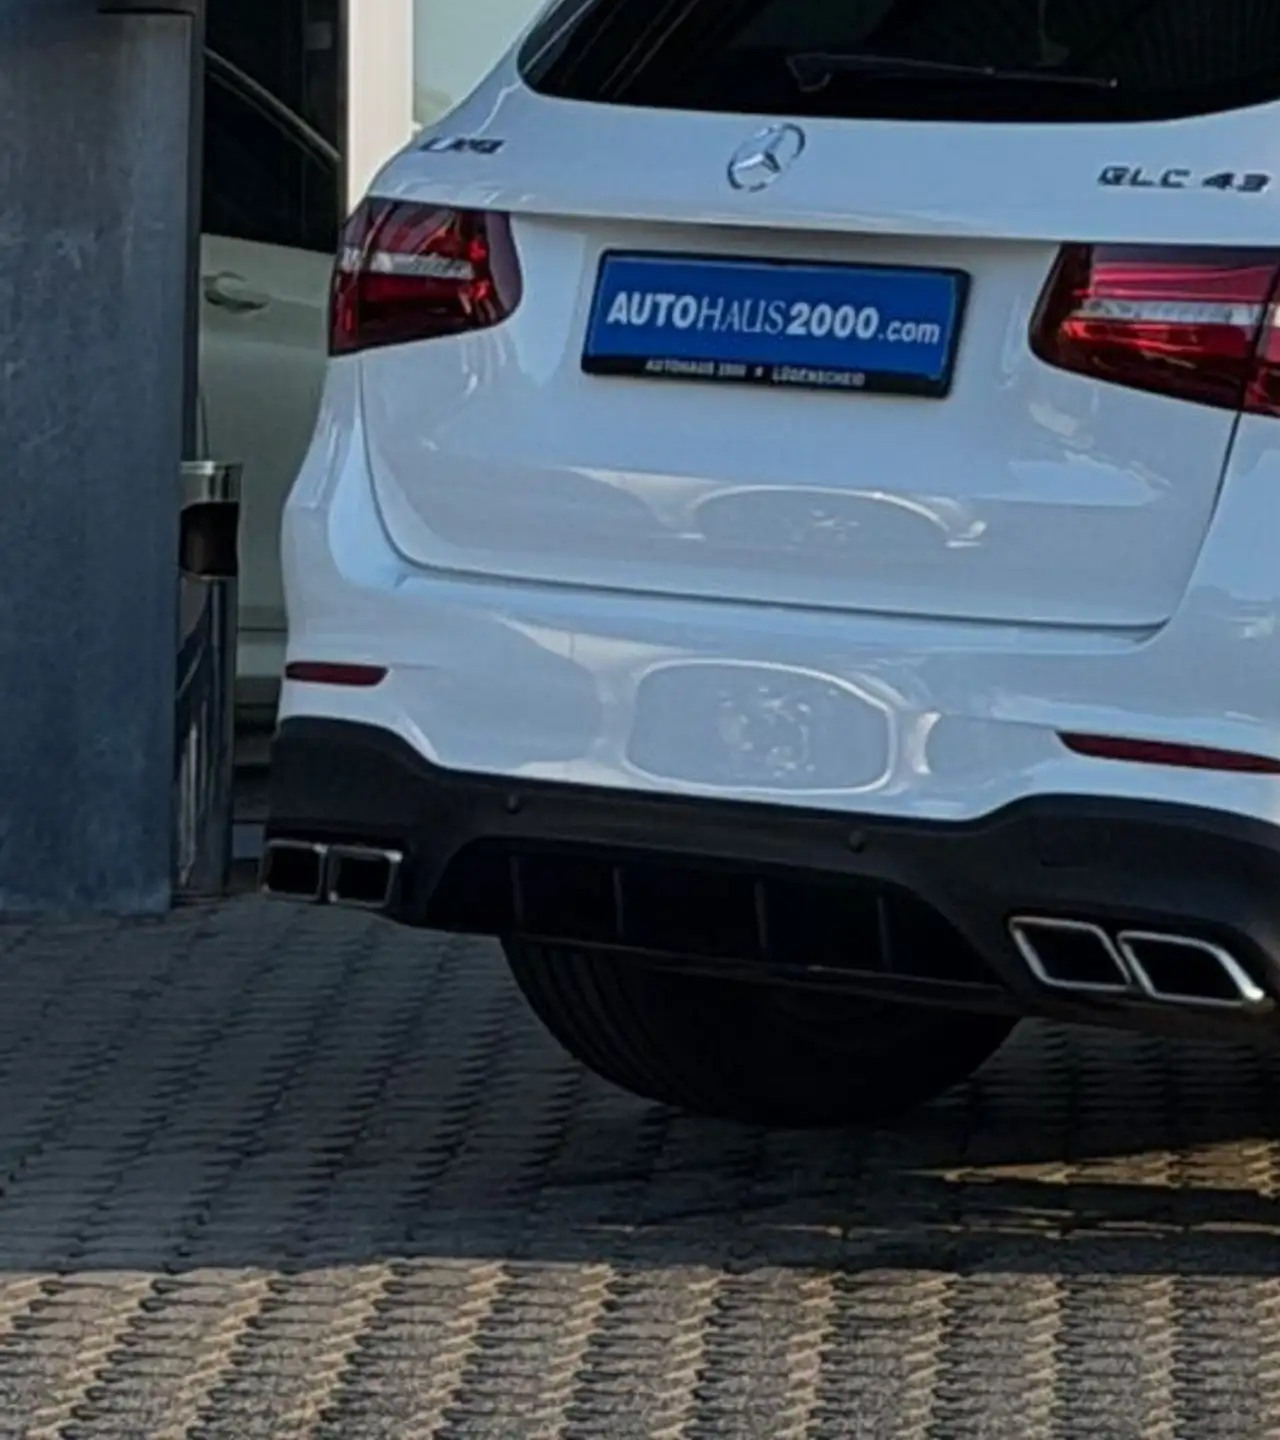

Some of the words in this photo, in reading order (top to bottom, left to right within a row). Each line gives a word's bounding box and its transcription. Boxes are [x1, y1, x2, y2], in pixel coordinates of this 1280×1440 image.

[1097, 165, 1192, 189] GLC
[1202, 171, 1271, 193] 43
[606, 291, 941, 345] AUTOHAUS2000.com
